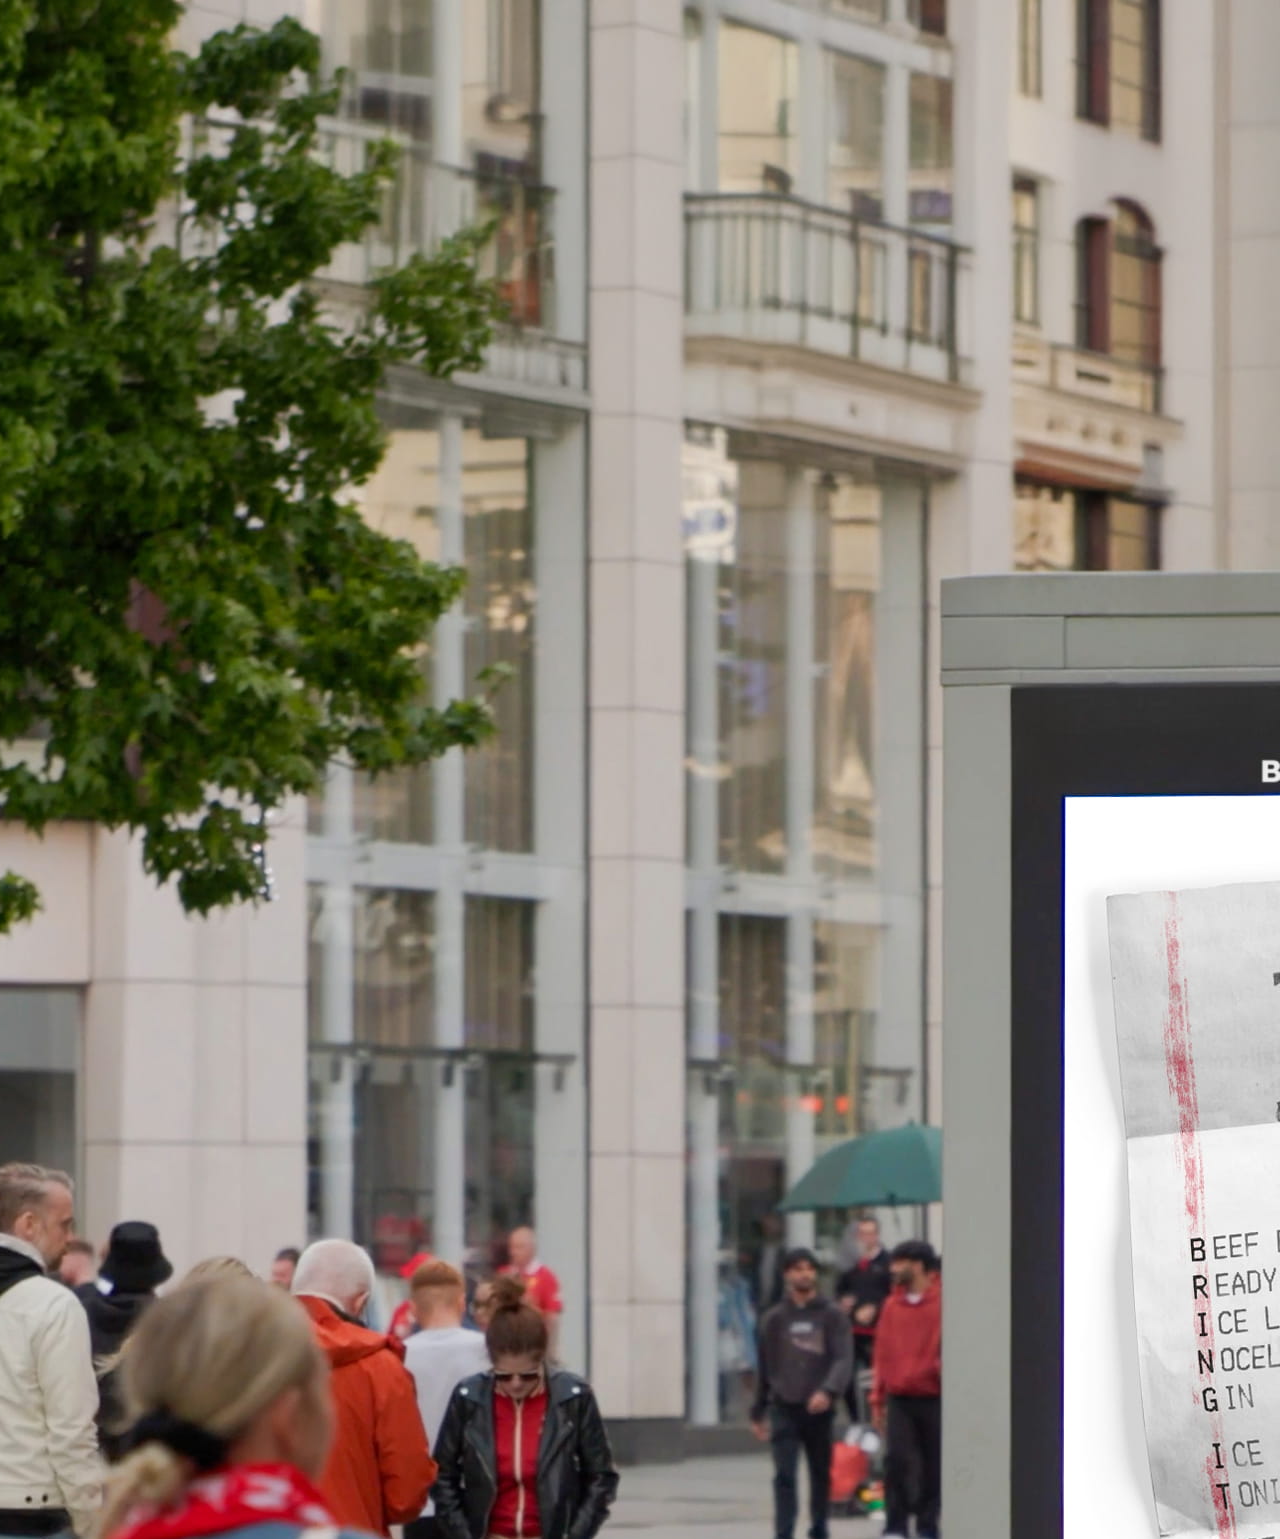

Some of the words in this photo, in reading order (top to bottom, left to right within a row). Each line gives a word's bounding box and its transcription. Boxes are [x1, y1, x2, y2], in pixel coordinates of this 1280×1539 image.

[1189, 1231, 1259, 1263] BEEF
[1192, 1267, 1277, 1301] READY
[1196, 1308, 1249, 1338] ICE
[1201, 1383, 1254, 1413] GIN
[1211, 1439, 1264, 1470] ICE
